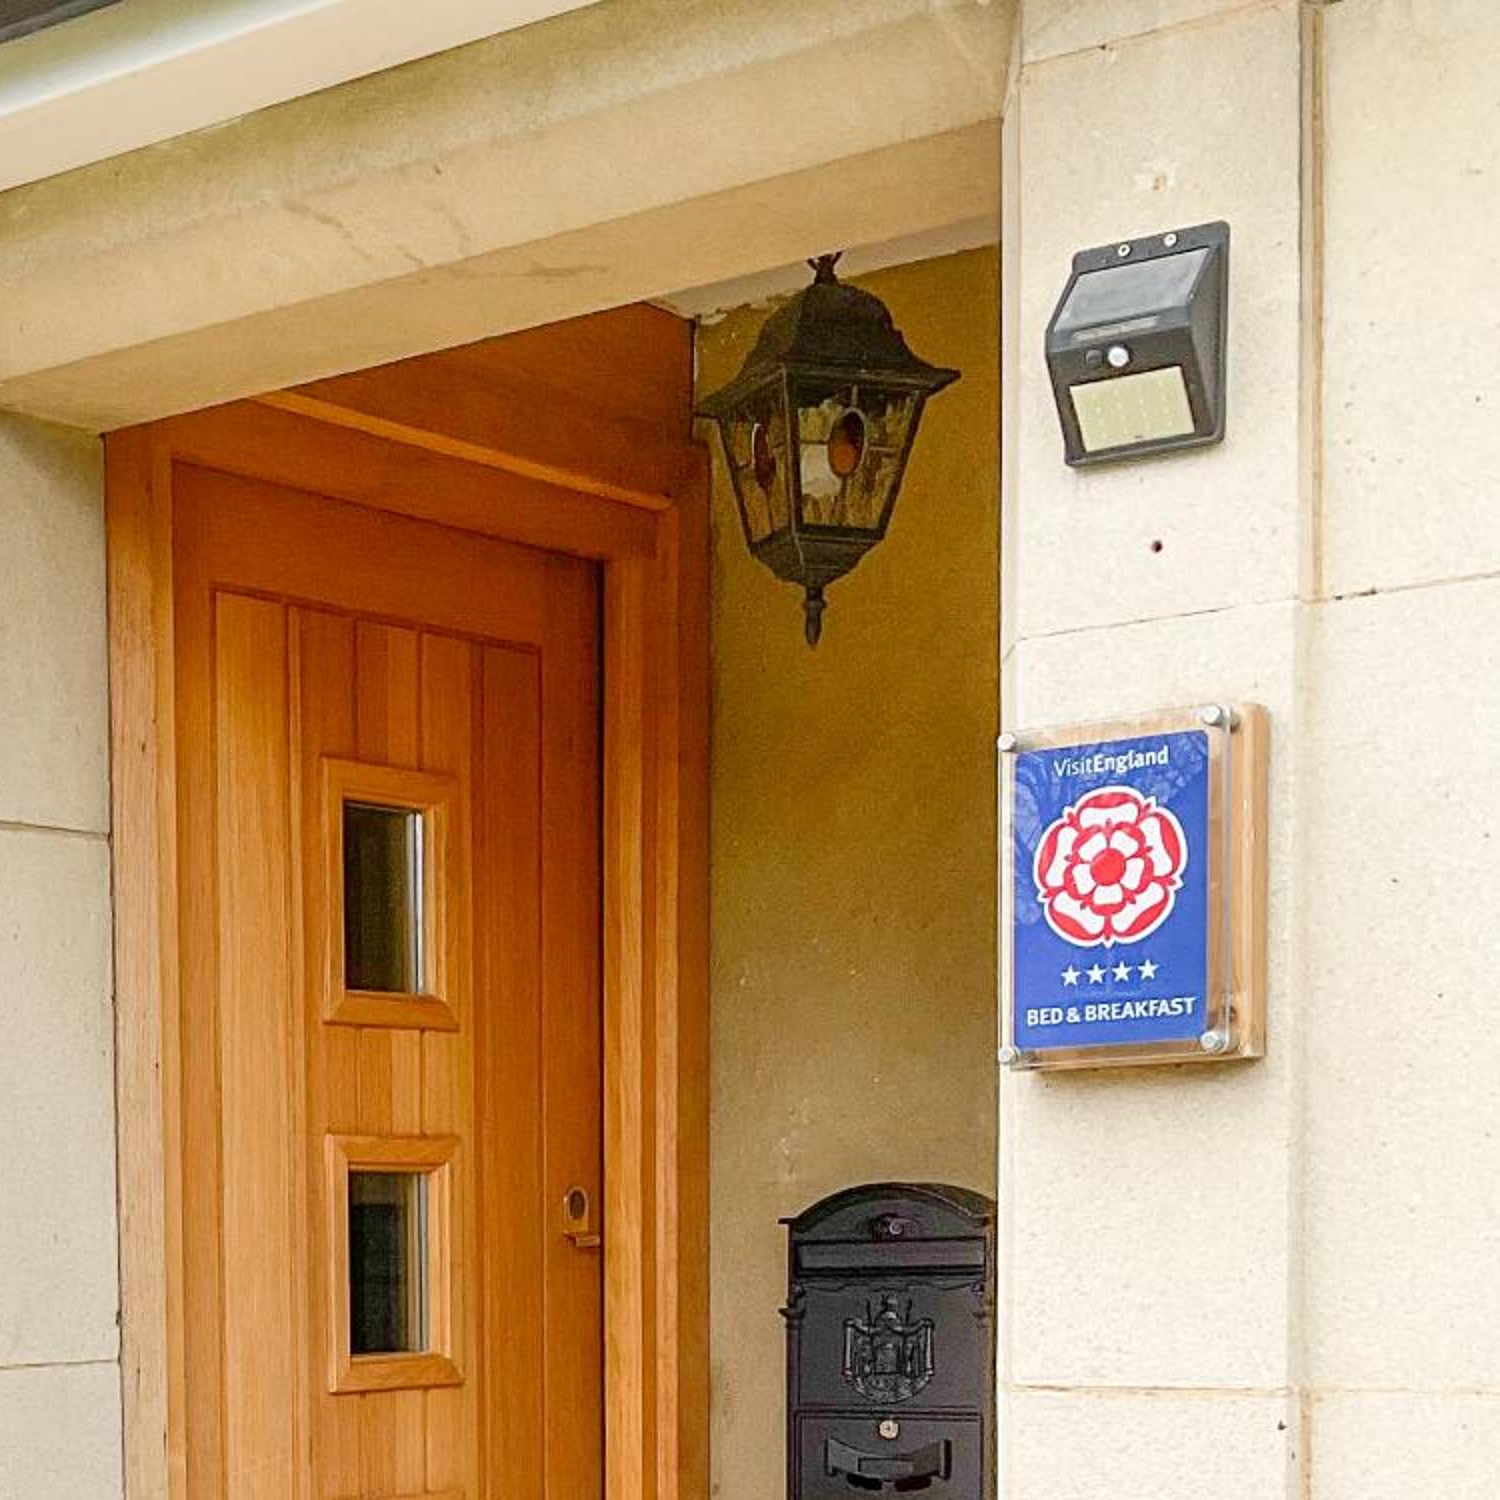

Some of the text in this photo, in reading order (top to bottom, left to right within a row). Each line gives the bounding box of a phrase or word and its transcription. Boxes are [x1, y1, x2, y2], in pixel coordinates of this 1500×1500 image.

[1053, 745, 1169, 777] VisitEngland
[1026, 996, 1197, 1026] BED & BREAKFAST
